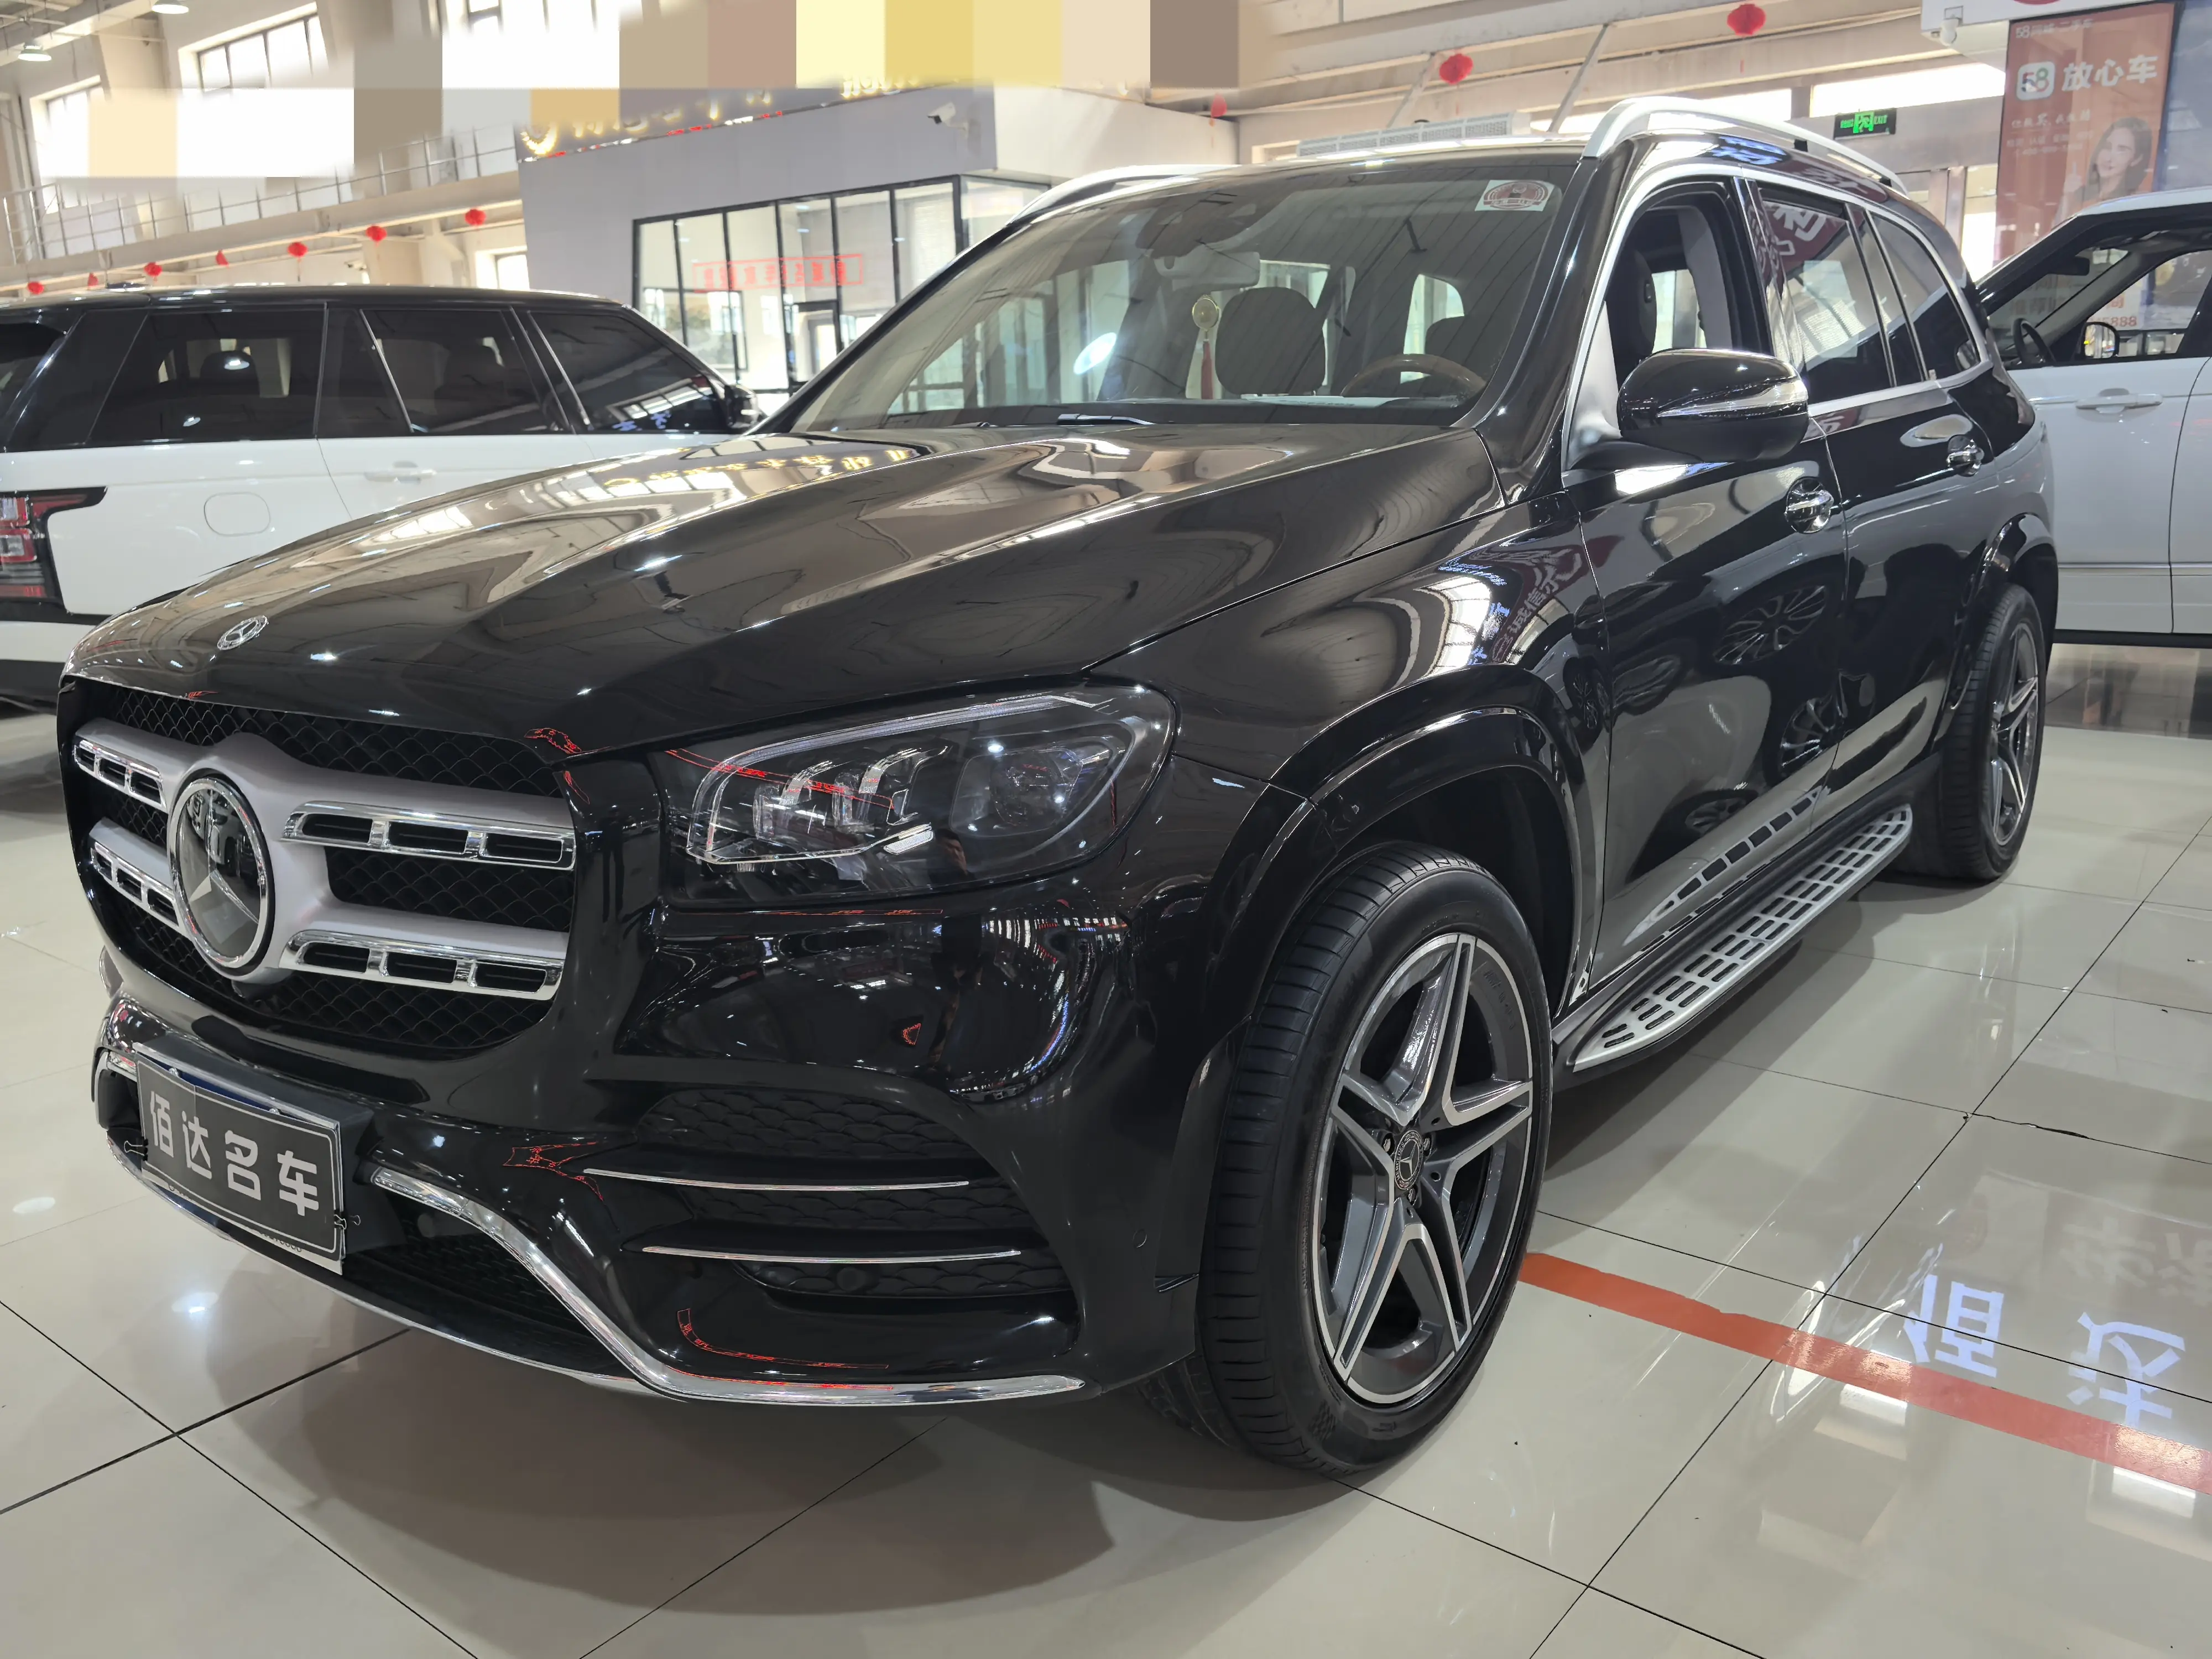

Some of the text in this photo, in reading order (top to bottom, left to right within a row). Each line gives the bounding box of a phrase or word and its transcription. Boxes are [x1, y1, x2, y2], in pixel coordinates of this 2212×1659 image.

[2061, 54, 2158, 92] 放心车
[150, 1091, 319, 1216] 佰达名车
